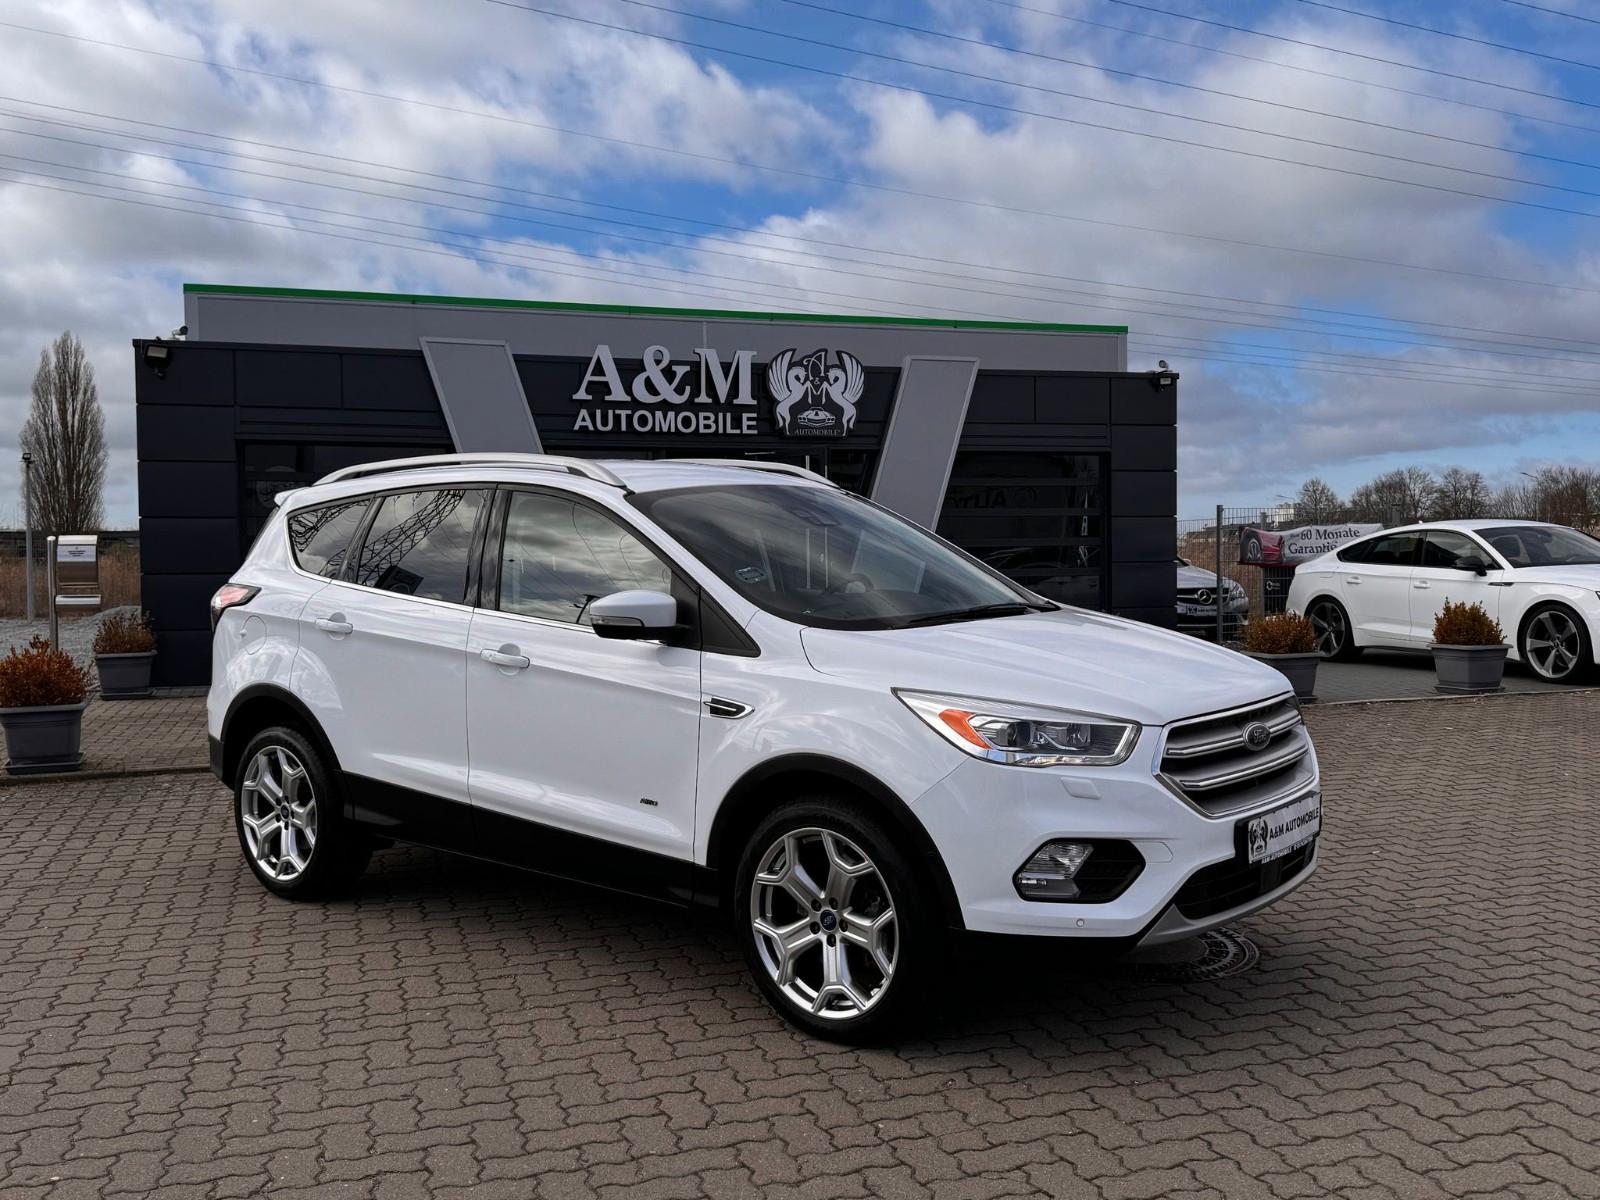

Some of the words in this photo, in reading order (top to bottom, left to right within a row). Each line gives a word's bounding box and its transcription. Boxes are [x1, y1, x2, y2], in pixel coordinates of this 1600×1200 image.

[572, 344, 758, 405] A&M
[573, 408, 758, 434] AUTOMOBILE
[1300, 529, 1313, 541] 60
[1315, 527, 1361, 540] Monate
[1269, 823, 1285, 841] A&M
[1285, 807, 1320, 834] AUTOMOBILE
